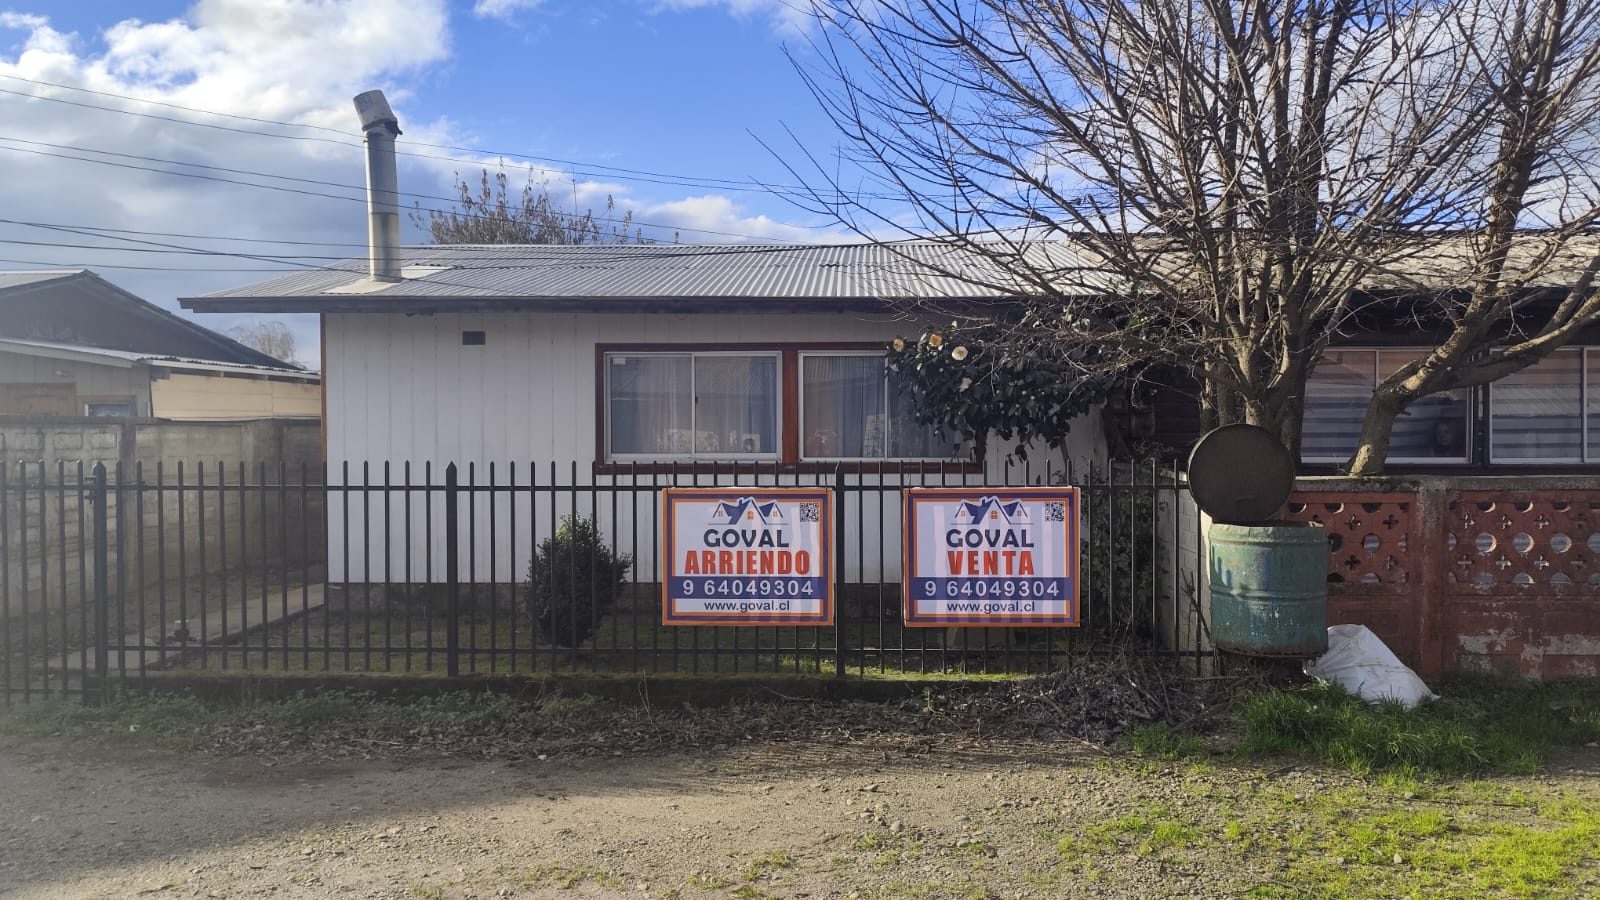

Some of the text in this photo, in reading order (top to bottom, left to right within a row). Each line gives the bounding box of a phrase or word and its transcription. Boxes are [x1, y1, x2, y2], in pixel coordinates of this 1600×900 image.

[703, 528, 789, 547] GOVAL
[946, 528, 1035, 548] GOVAL
[684, 550, 810, 575] ARRIENDO
[947, 551, 1034, 576] VENTA
[682, 579, 813, 596] 9 64049304
[924, 580, 1060, 597] 9 64049304
[703, 600, 790, 613] www.goval.cl
[946, 601, 1035, 615] www.goval.cl
